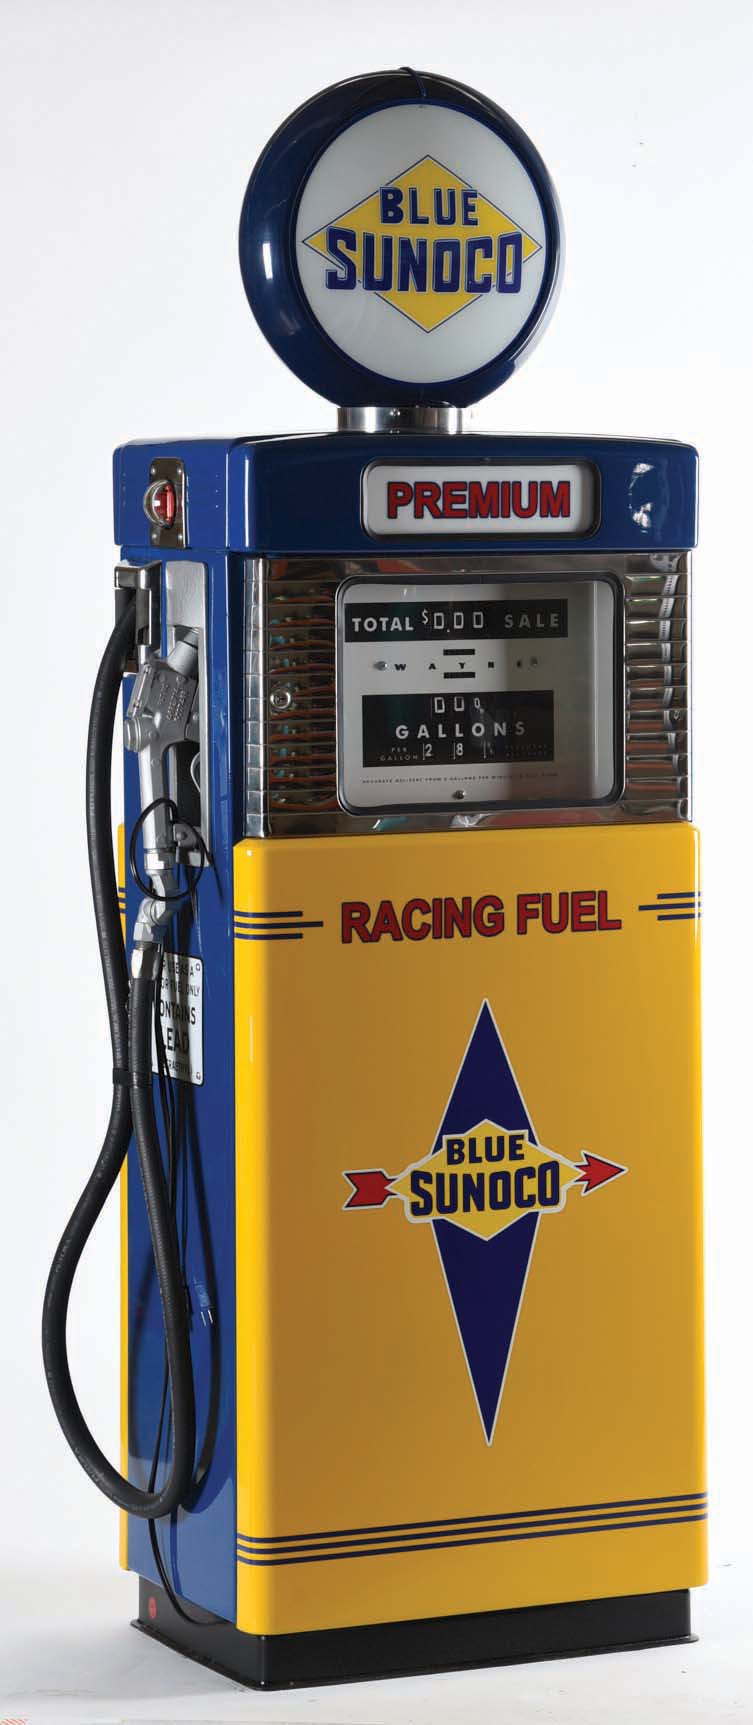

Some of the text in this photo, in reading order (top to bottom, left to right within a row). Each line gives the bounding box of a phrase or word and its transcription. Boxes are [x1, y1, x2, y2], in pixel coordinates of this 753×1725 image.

[379, 187, 478, 226] BLUE
[325, 226, 523, 294] SUNOCO
[386, 480, 571, 519] PREMIUM
[352, 617, 414, 633] TOTAL
[504, 613, 560, 629] SALE
[395, 721, 526, 739] GALLONS
[341, 890, 622, 944] RACING FUEL
[160, 1000, 196, 1025] ONTAINS
[164, 1027, 190, 1055] EAD
[446, 1134, 525, 1166] BLUE
[410, 1160, 560, 1217] SUNOCO
